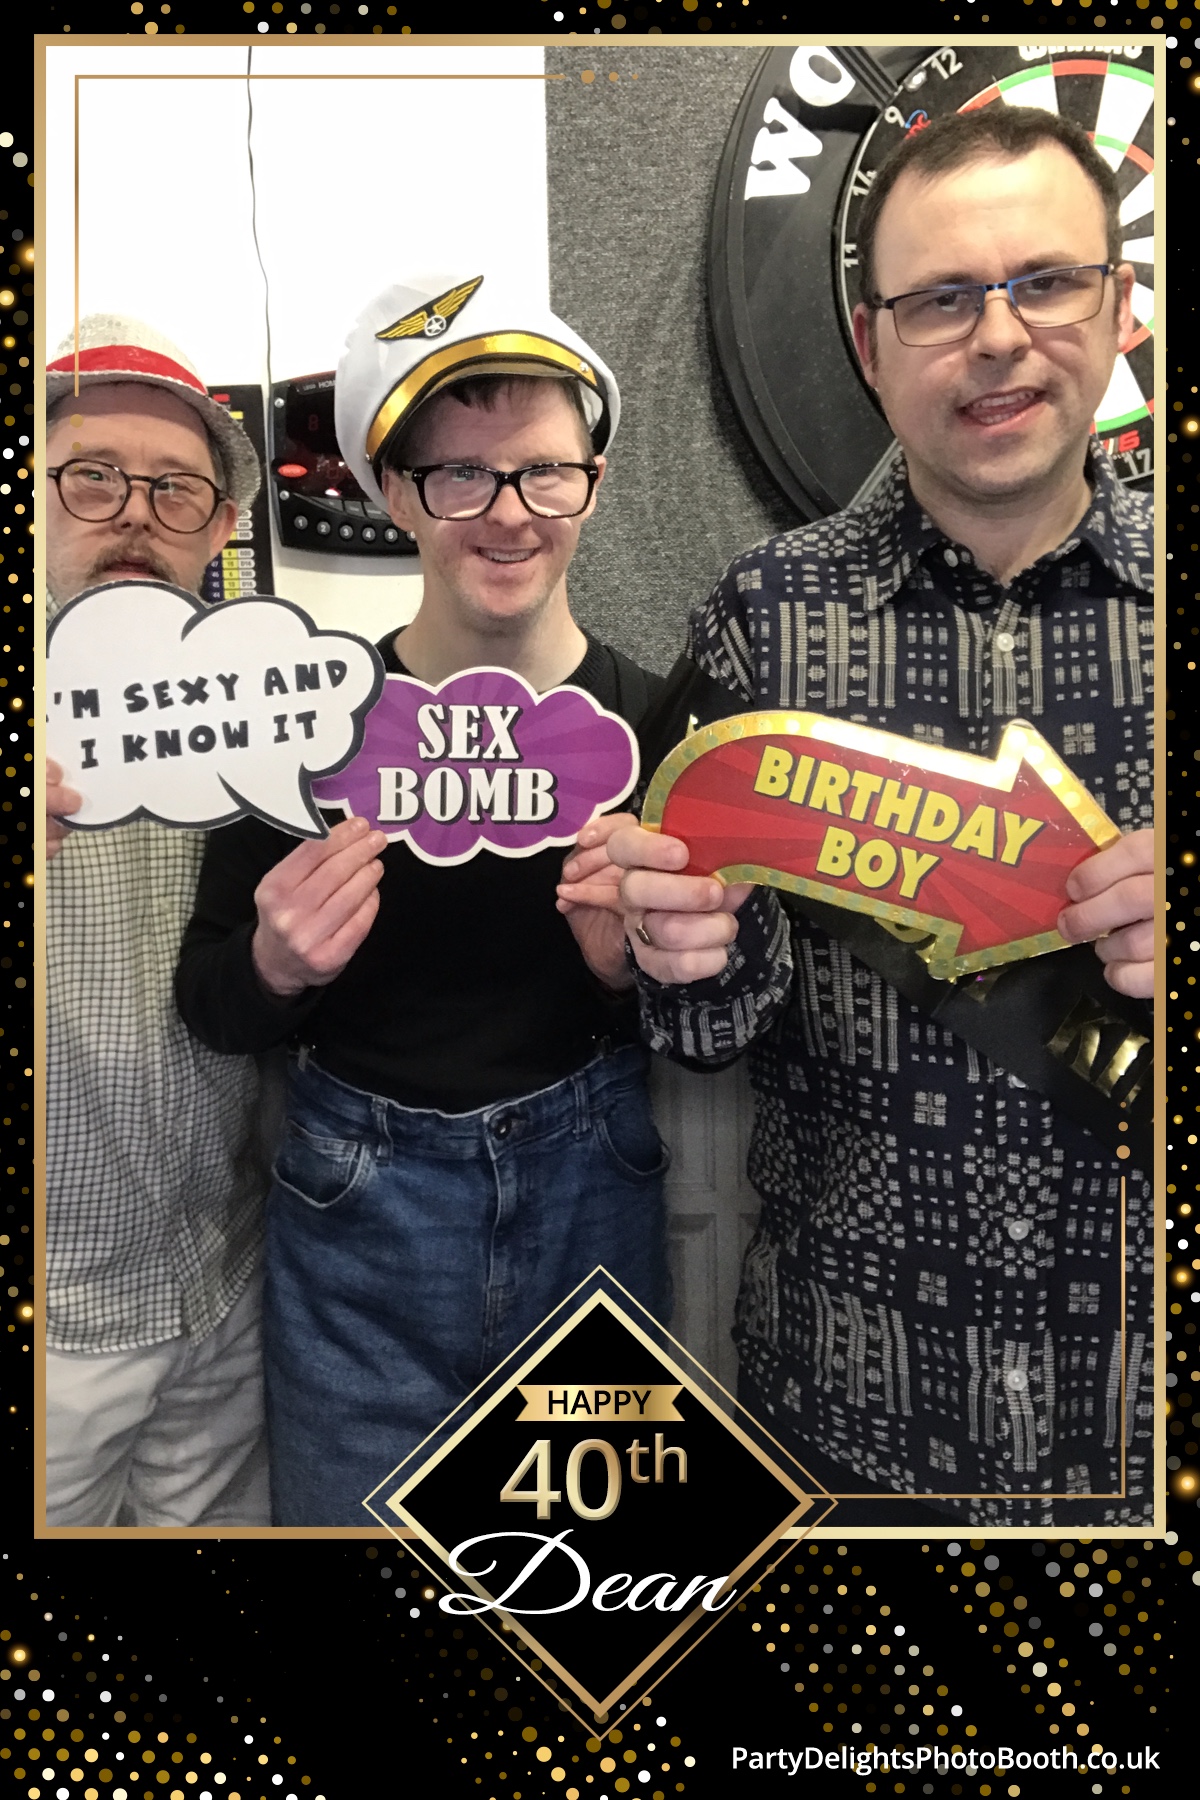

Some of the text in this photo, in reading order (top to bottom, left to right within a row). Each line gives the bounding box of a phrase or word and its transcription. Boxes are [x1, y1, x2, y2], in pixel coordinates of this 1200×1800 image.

[931, 48, 963, 80] 12
[884, 105, 905, 128] 9
[844, 243, 859, 268] 11
[1124, 447, 1151, 477] 17
[298, 519, 303, 527] 1
[320, 524, 327, 533] 2
[343, 528, 349, 537] 3
[365, 531, 372, 539] 4
[388, 532, 394, 540] 5
[46, 660, 347, 720] 'M SEXY AND
[81, 710, 317, 769] I KNOW IT
[417, 703, 522, 761] SEX
[376, 766, 557, 823] BOMB
[753, 745, 1045, 867] BIRTHDAY
[816, 826, 942, 899] BOY
